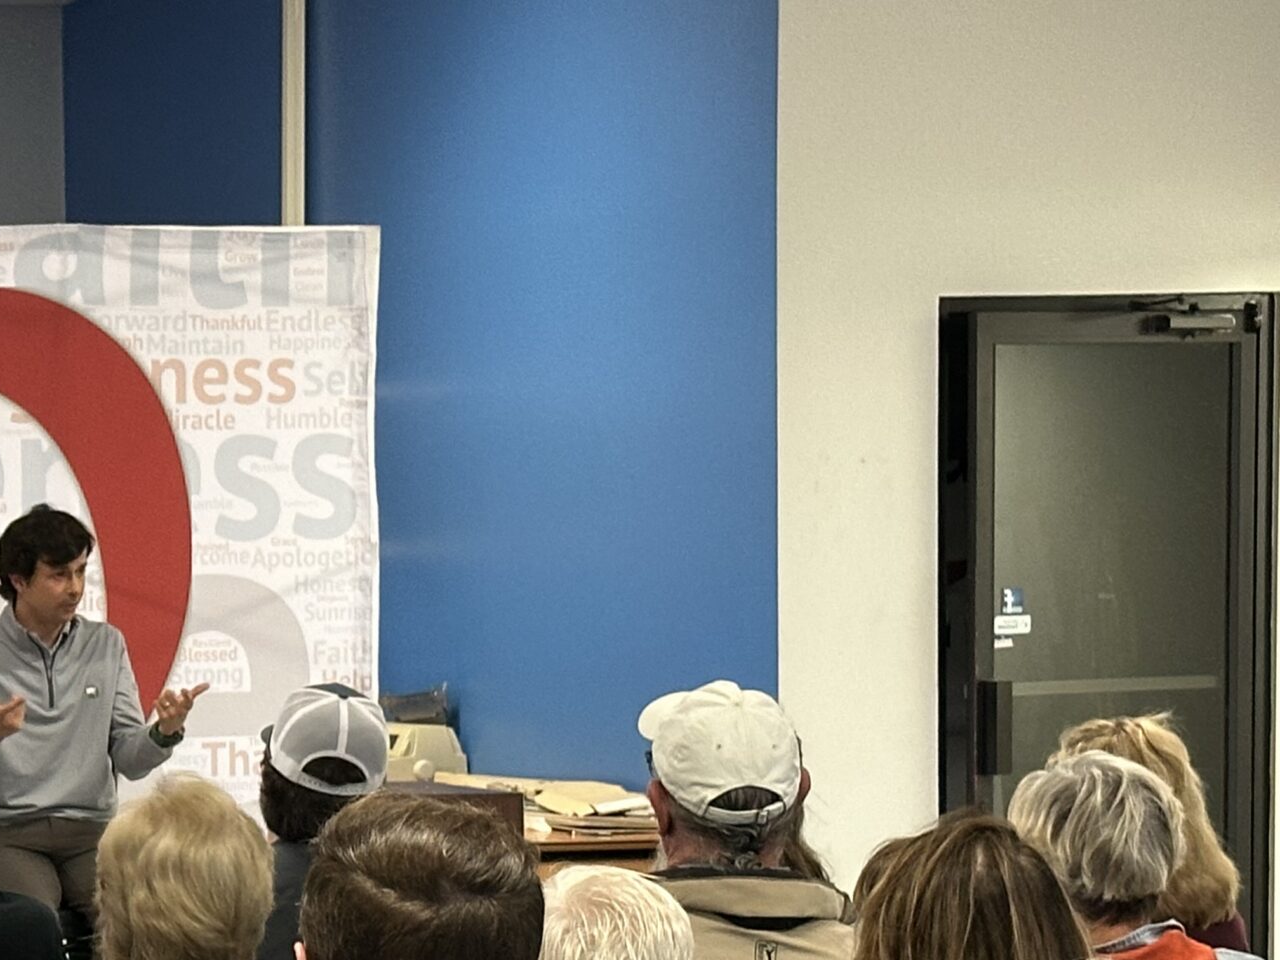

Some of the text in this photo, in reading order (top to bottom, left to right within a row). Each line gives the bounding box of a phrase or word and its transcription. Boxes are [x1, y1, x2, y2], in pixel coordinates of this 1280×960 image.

[188, 313, 263, 331] Thankful
[146, 334, 246, 355] Maintain
[268, 336, 344, 356] Happine
[265, 408, 354, 431] Humble
